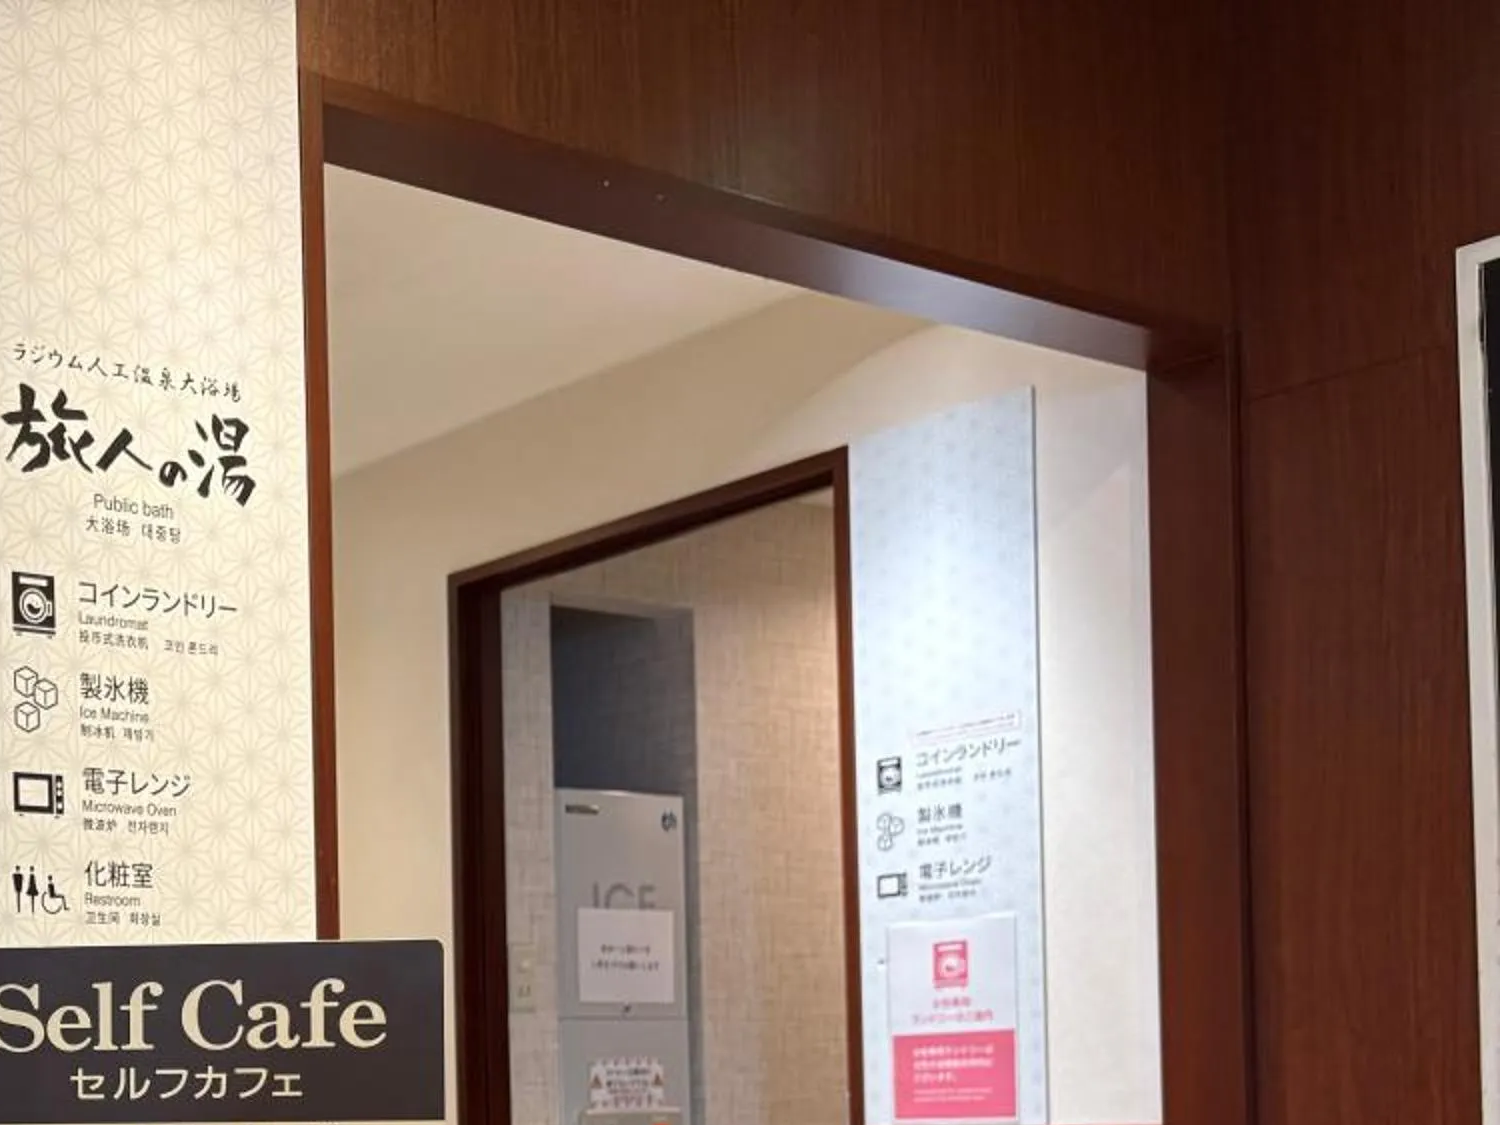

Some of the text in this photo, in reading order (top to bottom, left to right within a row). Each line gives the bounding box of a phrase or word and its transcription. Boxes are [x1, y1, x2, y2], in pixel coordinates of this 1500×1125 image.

[13, 343, 241, 402] ラジウム人工温泉大浴場
[0, 382, 257, 507] 旅人の湯
[93, 494, 174, 520] Public bath
[78, 581, 238, 619] コインランドリー
[78, 611, 149, 631] Laundromat
[80, 672, 149, 704] 製氷機
[80, 704, 149, 724] Ice Machine
[82, 767, 191, 797] 電子レンジ
[82, 799, 178, 817] Microwave Oven
[84, 860, 154, 889] 化粧室
[84, 892, 141, 908] Restroom
[181, 977, 388, 1051] Cafe
[69, 1066, 304, 1100] セルフカフェ
